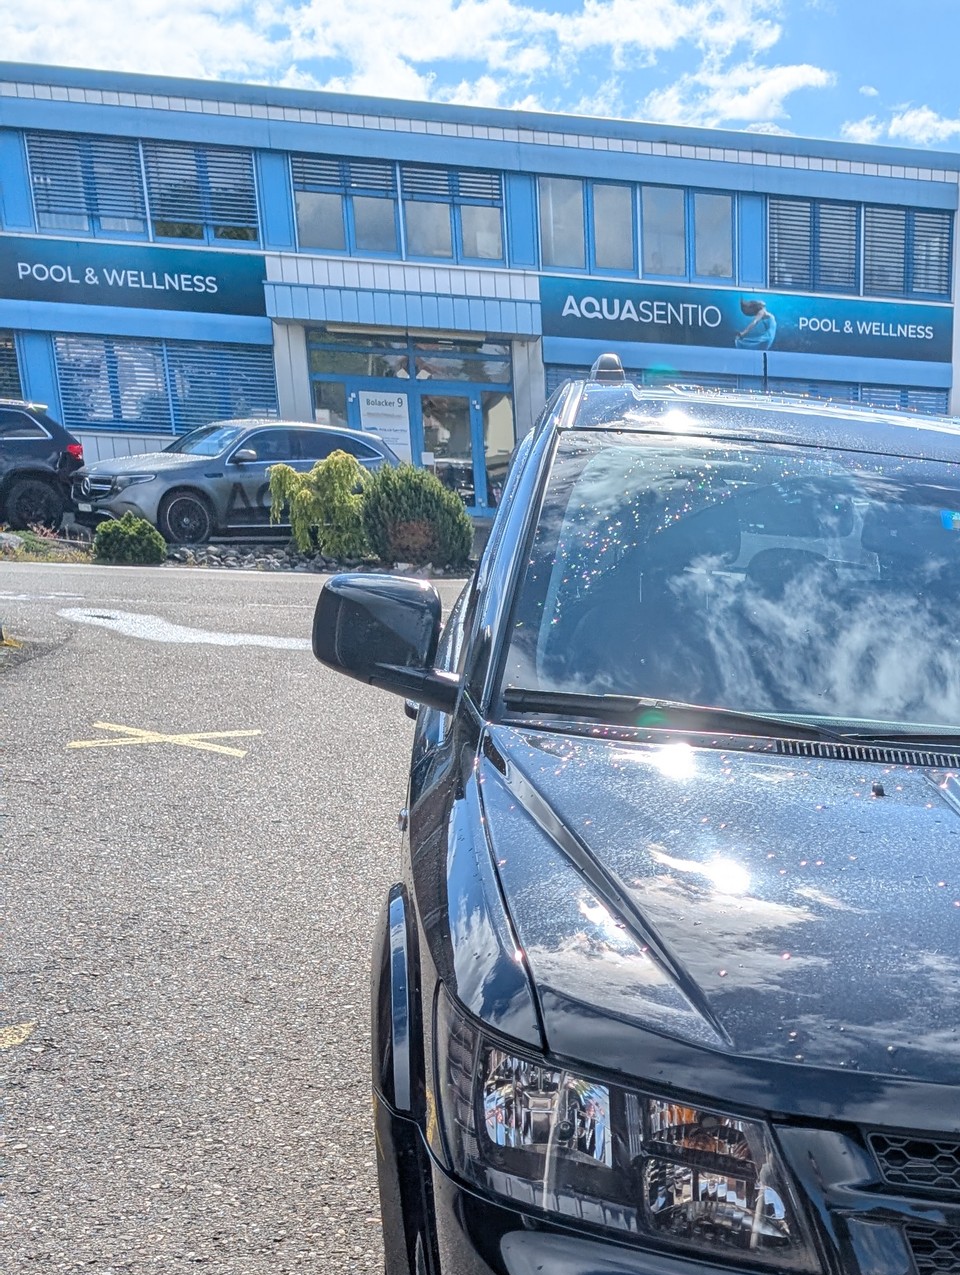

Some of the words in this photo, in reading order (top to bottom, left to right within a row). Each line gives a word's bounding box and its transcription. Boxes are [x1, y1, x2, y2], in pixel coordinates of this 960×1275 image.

[17, 262, 80, 284] POOL
[84, 267, 99, 285] &
[103, 268, 218, 293] WELLNESS
[561, 295, 722, 328] AQUASENTIO
[799, 317, 840, 333] POOL
[843, 320, 853, 334] &
[856, 320, 934, 339] WELLNESS
[366, 398, 395, 407] Bolacker
[396, 397, 403, 407] 9
